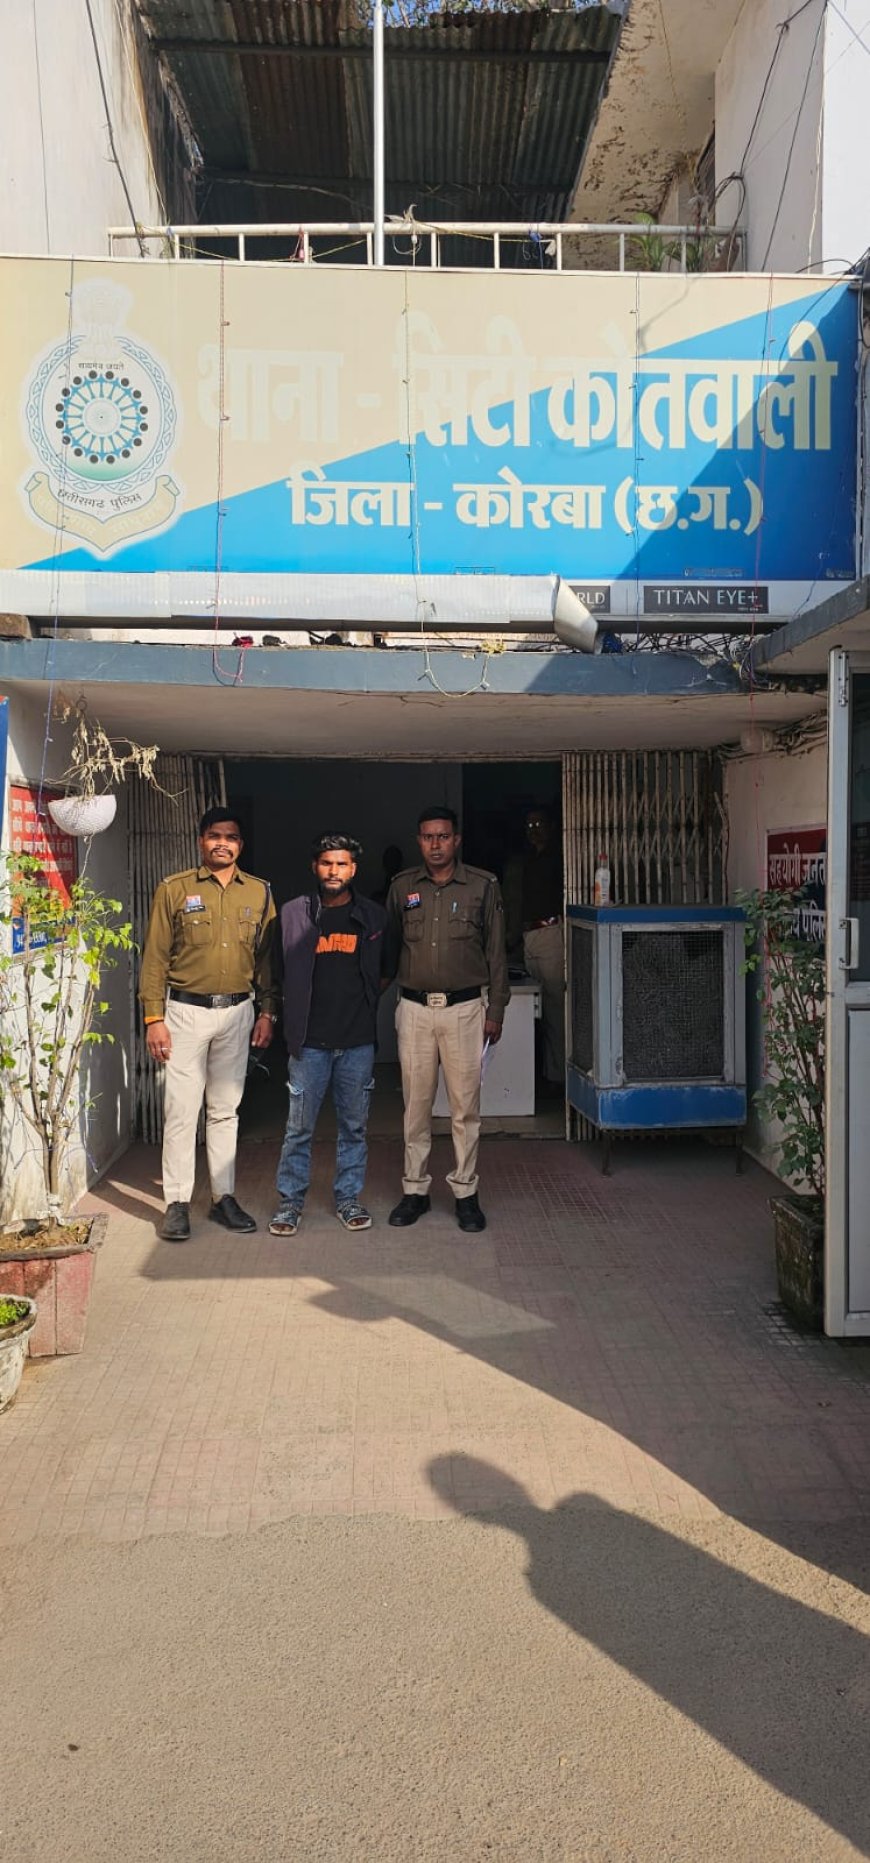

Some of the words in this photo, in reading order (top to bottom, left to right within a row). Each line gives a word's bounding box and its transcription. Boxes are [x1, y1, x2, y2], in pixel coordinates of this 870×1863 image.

[198, 343, 344, 442] थाना
[392, 311, 535, 447] सिटी
[537, 320, 838, 450] कोतवाली
[110, 493, 142, 511] पुलिस
[286, 459, 415, 527] जिला
[453, 466, 606, 529] कोरबा
[614, 476, 764, 536] (छ.ग.)
[577, 592, 605, 605] RLD
[653, 589, 709, 606] TITAN
[717, 590, 759, 606] EYE+
[769, 842, 801, 886] सहयोगी
[802, 852, 826, 886] जनत
